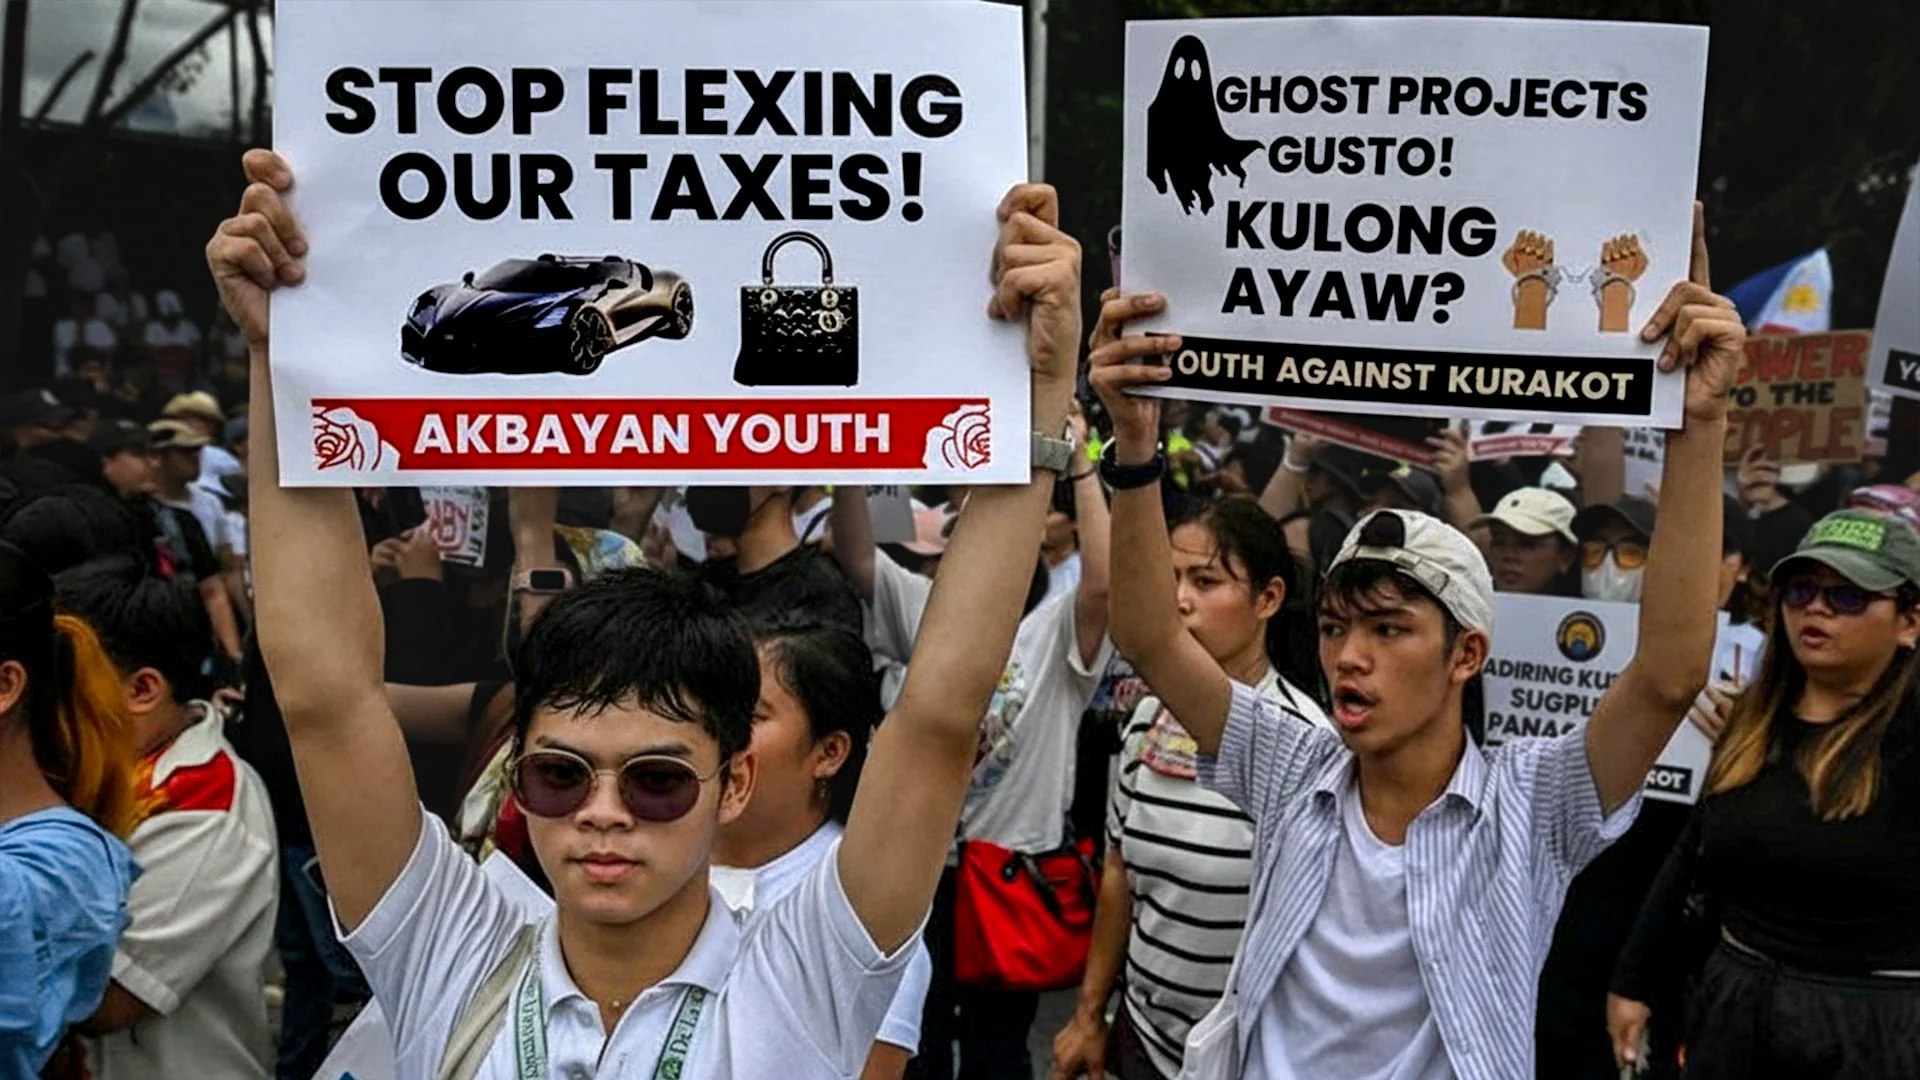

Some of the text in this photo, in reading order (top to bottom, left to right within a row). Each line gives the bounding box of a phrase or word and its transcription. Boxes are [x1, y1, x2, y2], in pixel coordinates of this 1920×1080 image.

[326, 67, 963, 137] STOP FLEXING
[1216, 75, 1648, 122] GHOST PROJECTS
[1268, 135, 1453, 178] GUSTO!
[380, 151, 923, 222] OUR TAXES!
[1226, 200, 1497, 257] KULONG
[1221, 267, 1465, 324] AYAW?
[1277, 356, 1436, 391] AGAINST
[1449, 365, 1634, 401] KURAKOT
[1729, 381, 1835, 407] O THE
[413, 411, 890, 455] AKBAYAN YOUTH
[1484, 658, 1574, 686] ADIRING
[1510, 687, 1600, 717] SUGPU
